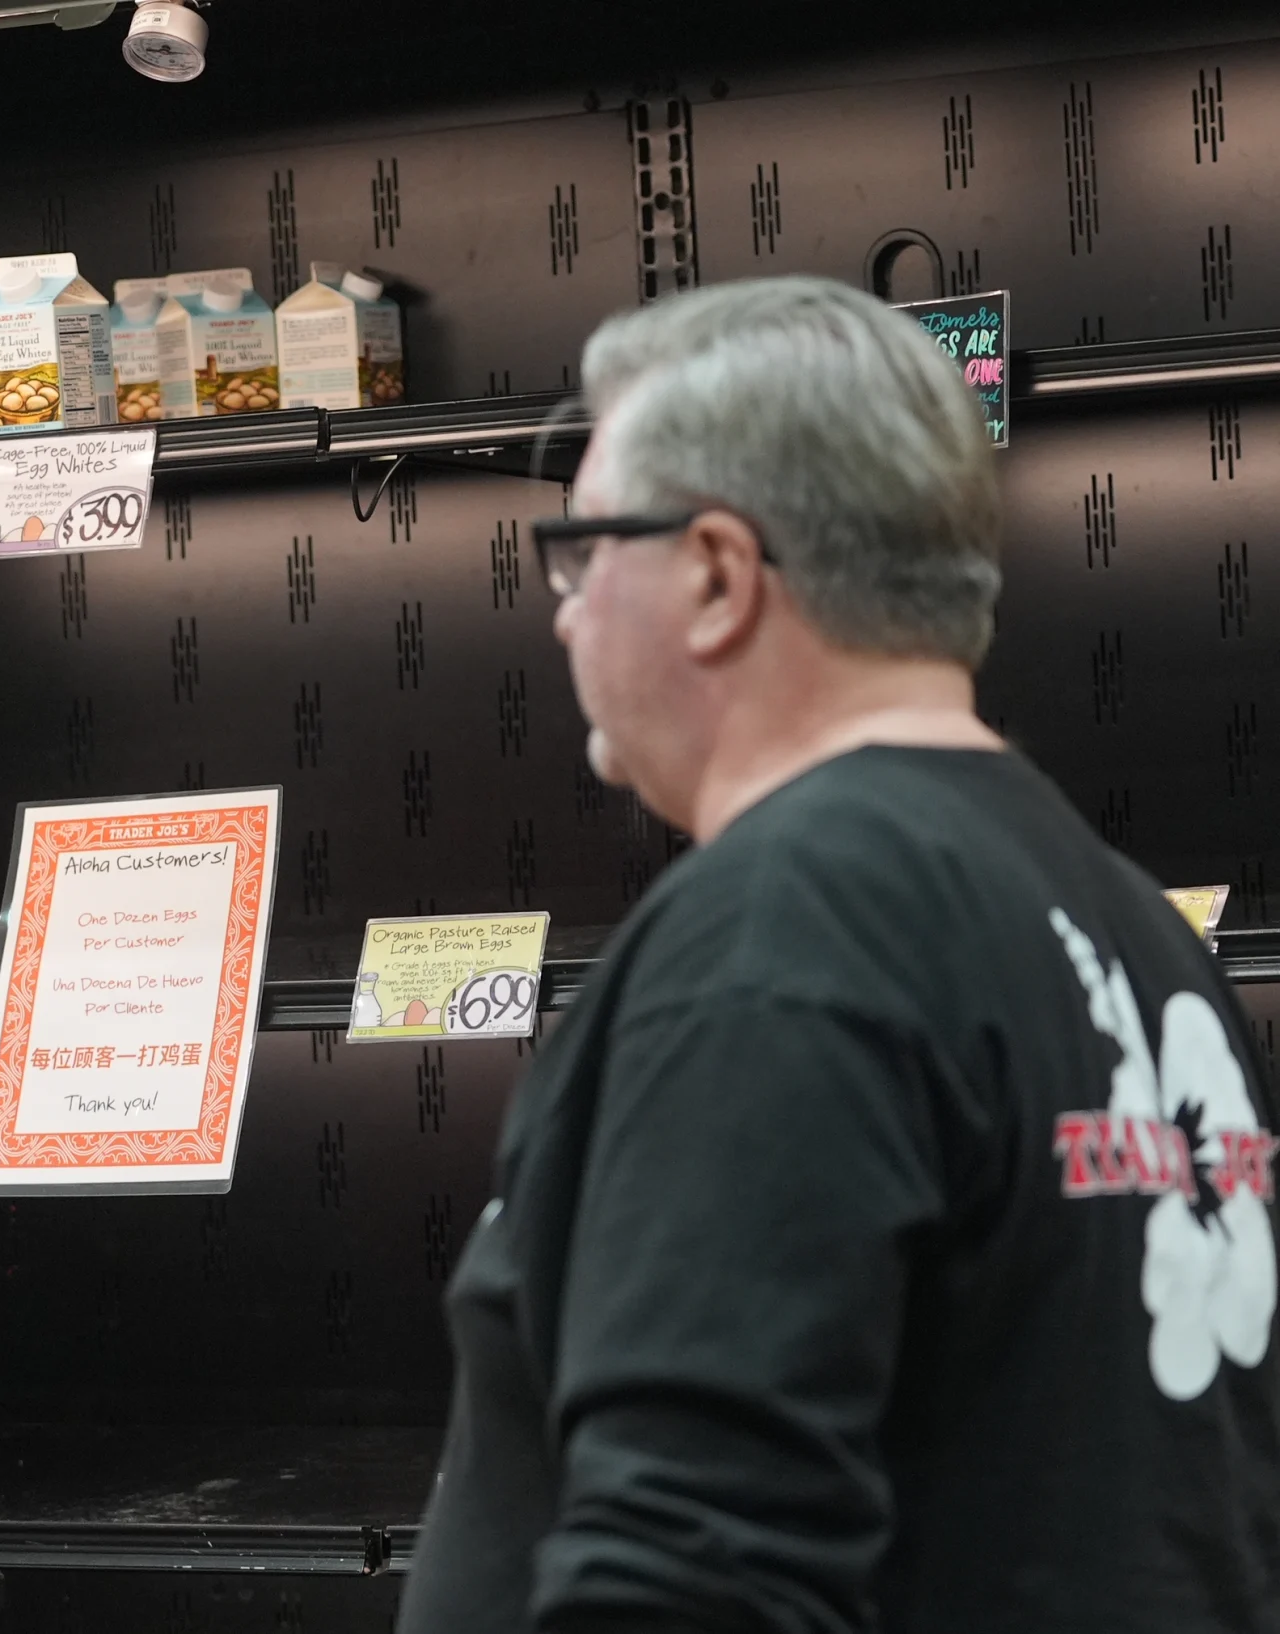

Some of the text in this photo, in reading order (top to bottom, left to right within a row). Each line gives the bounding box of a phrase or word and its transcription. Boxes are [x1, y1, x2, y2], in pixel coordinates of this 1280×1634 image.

[8, 332, 40, 347] Liquid
[964, 329, 999, 358] ARE
[16, 347, 52, 359] Whites
[964, 358, 1004, 387] ONE
[978, 387, 1000, 403] nd
[76, 441, 107, 456] 100%
[111, 439, 148, 455] Liquid
[14, 455, 118, 480] Egg Whites
[108, 823, 190, 841] TRADER JOE'S
[64, 845, 229, 876] Aloha Customers!
[77, 909, 198, 928] One Dozen Eggs
[372, 922, 537, 944] Organic Pasture Raised
[83, 934, 185, 951] Per Customer
[390, 938, 513, 957] Large Brown Eggs
[391, 961, 420, 971] Grade
[422, 961, 429, 970] A
[431, 961, 451, 971] eggs
[475, 959, 496, 967] hens
[52, 974, 204, 992] Una Docena De Huevo
[399, 970, 420, 979] given
[400, 977, 415, 986] and
[416, 977, 441, 985] never
[442, 975, 459, 984] fed
[390, 984, 442, 994] hormones or
[393, 993, 437, 1002] antibiotics
[84, 1000, 165, 1017] Por Cliente
[29, 1042, 204, 1071] 每位顾客一打鸡蛋
[63, 1090, 159, 1117] Thank you!
